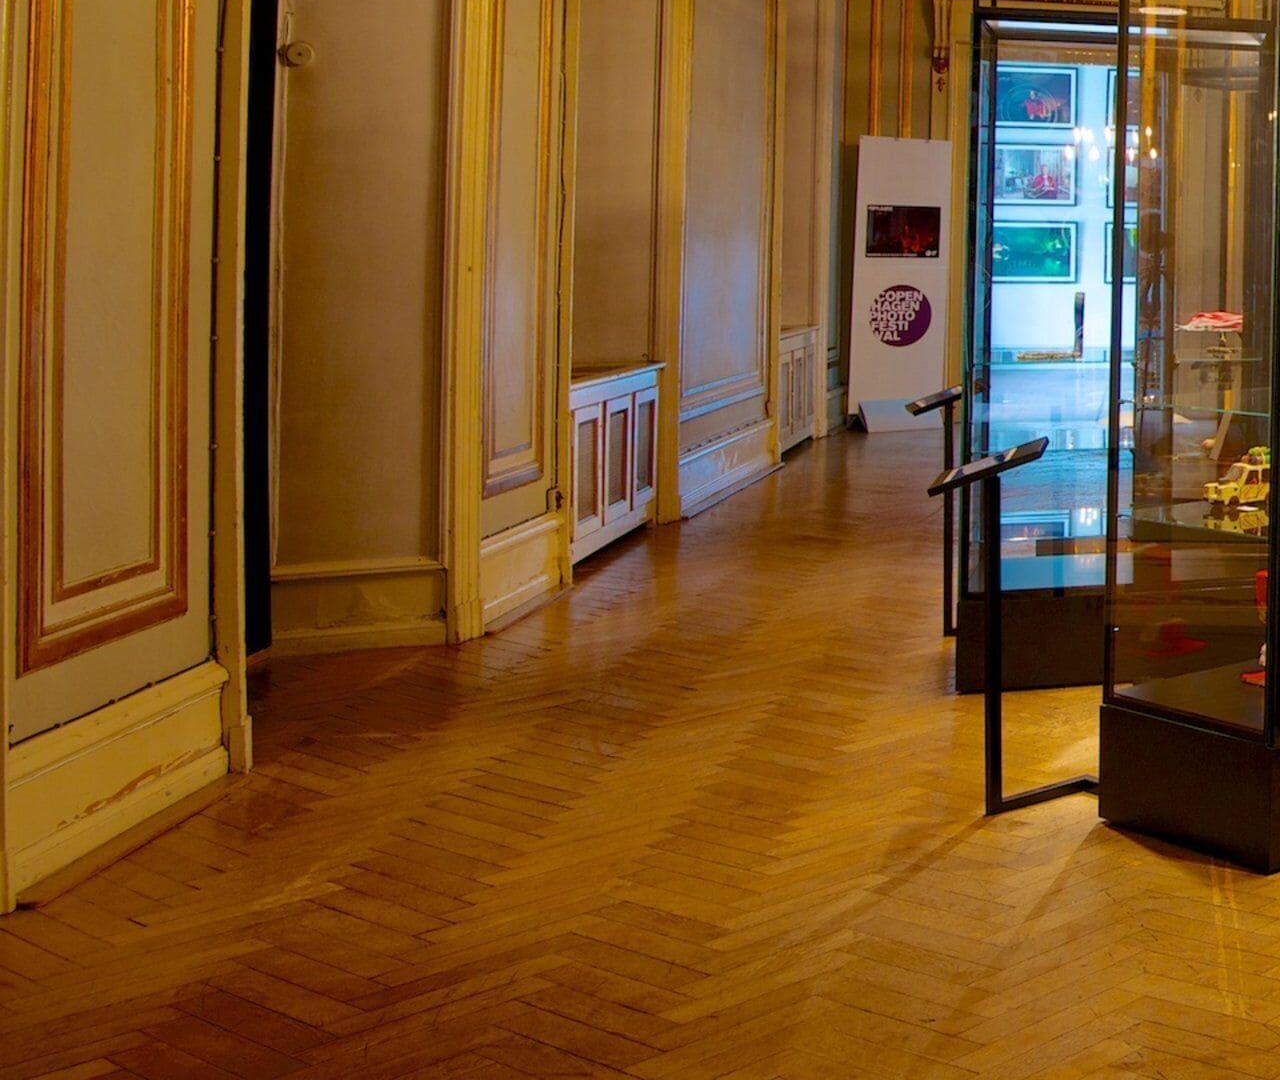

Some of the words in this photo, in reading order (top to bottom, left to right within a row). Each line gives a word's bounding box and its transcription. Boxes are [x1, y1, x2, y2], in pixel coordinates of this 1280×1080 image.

[877, 290, 923, 302] COPEN
[872, 300, 920, 311] HAGEN
[869, 310, 916, 321] PHOTO
[871, 320, 909, 331] FESTI
